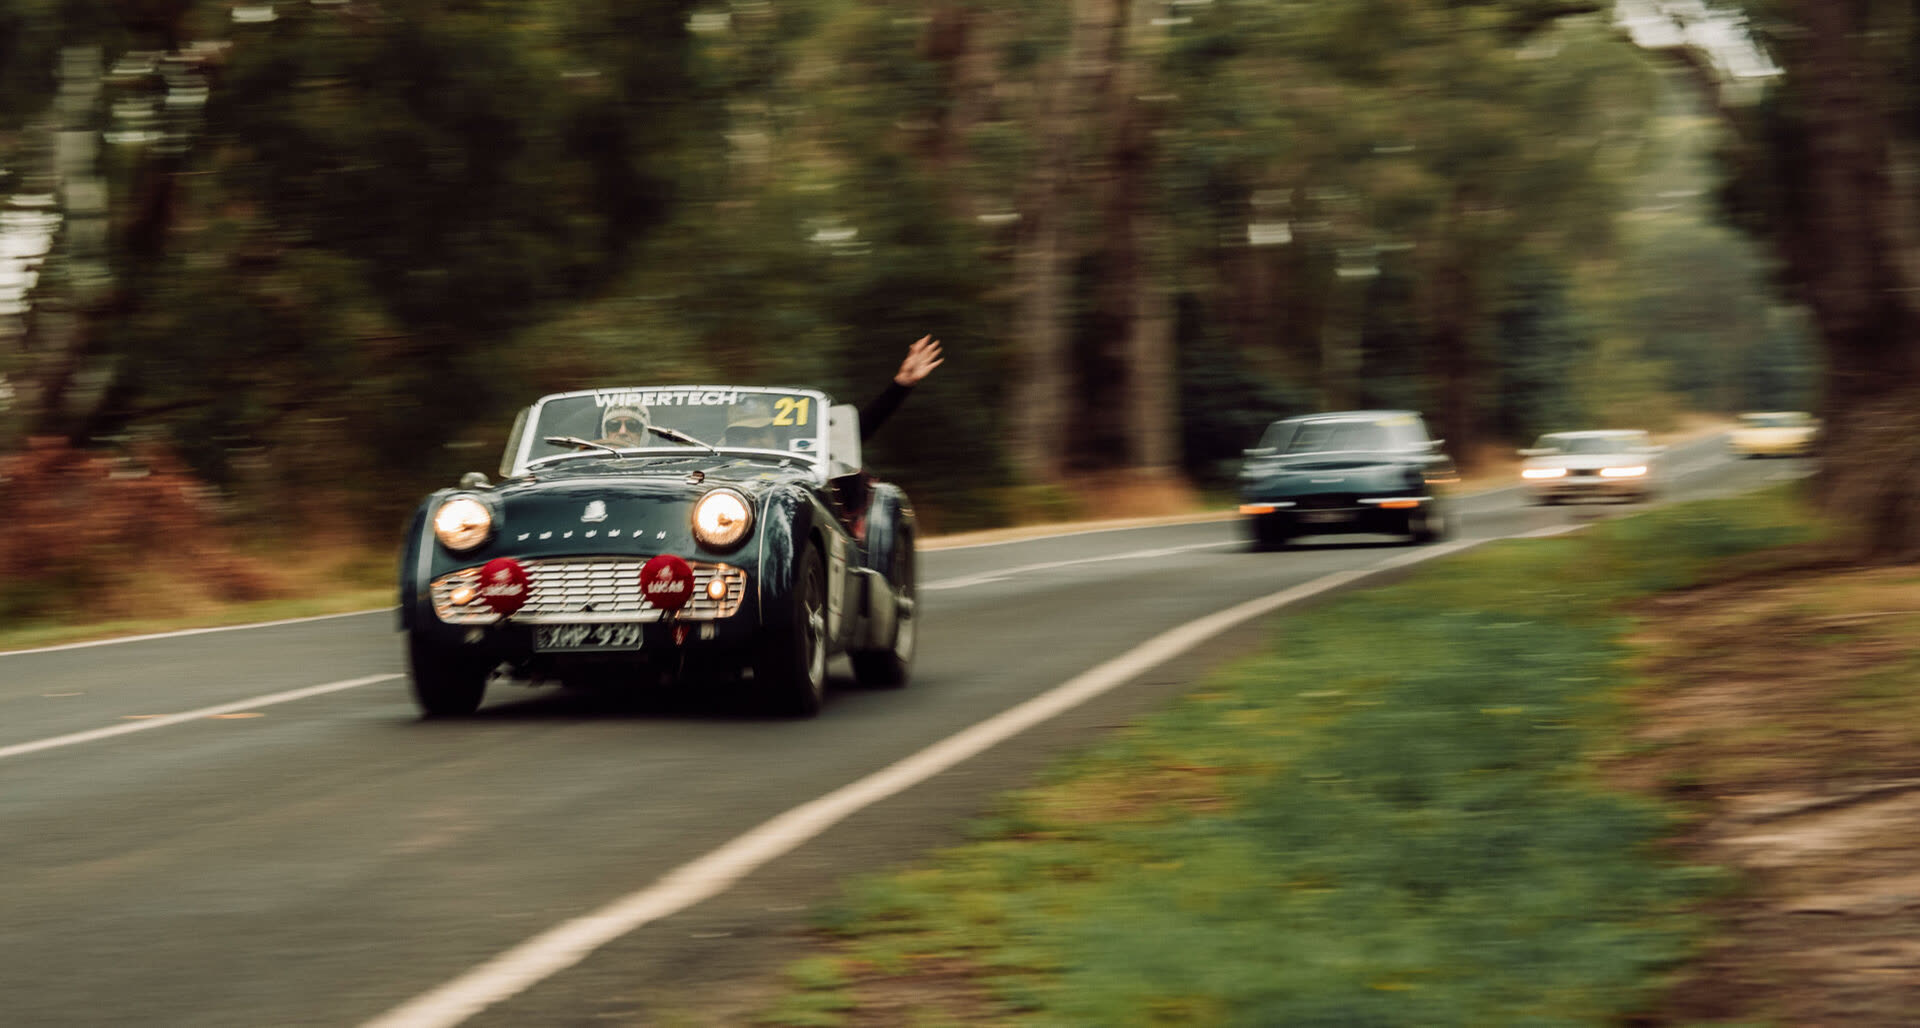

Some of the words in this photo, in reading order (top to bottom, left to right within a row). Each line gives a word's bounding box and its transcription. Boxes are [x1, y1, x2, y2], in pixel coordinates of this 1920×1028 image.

[594, 391, 737, 407] WIPERTECH
[773, 397, 810, 426] 21
[648, 580, 684, 593] LUCAS
